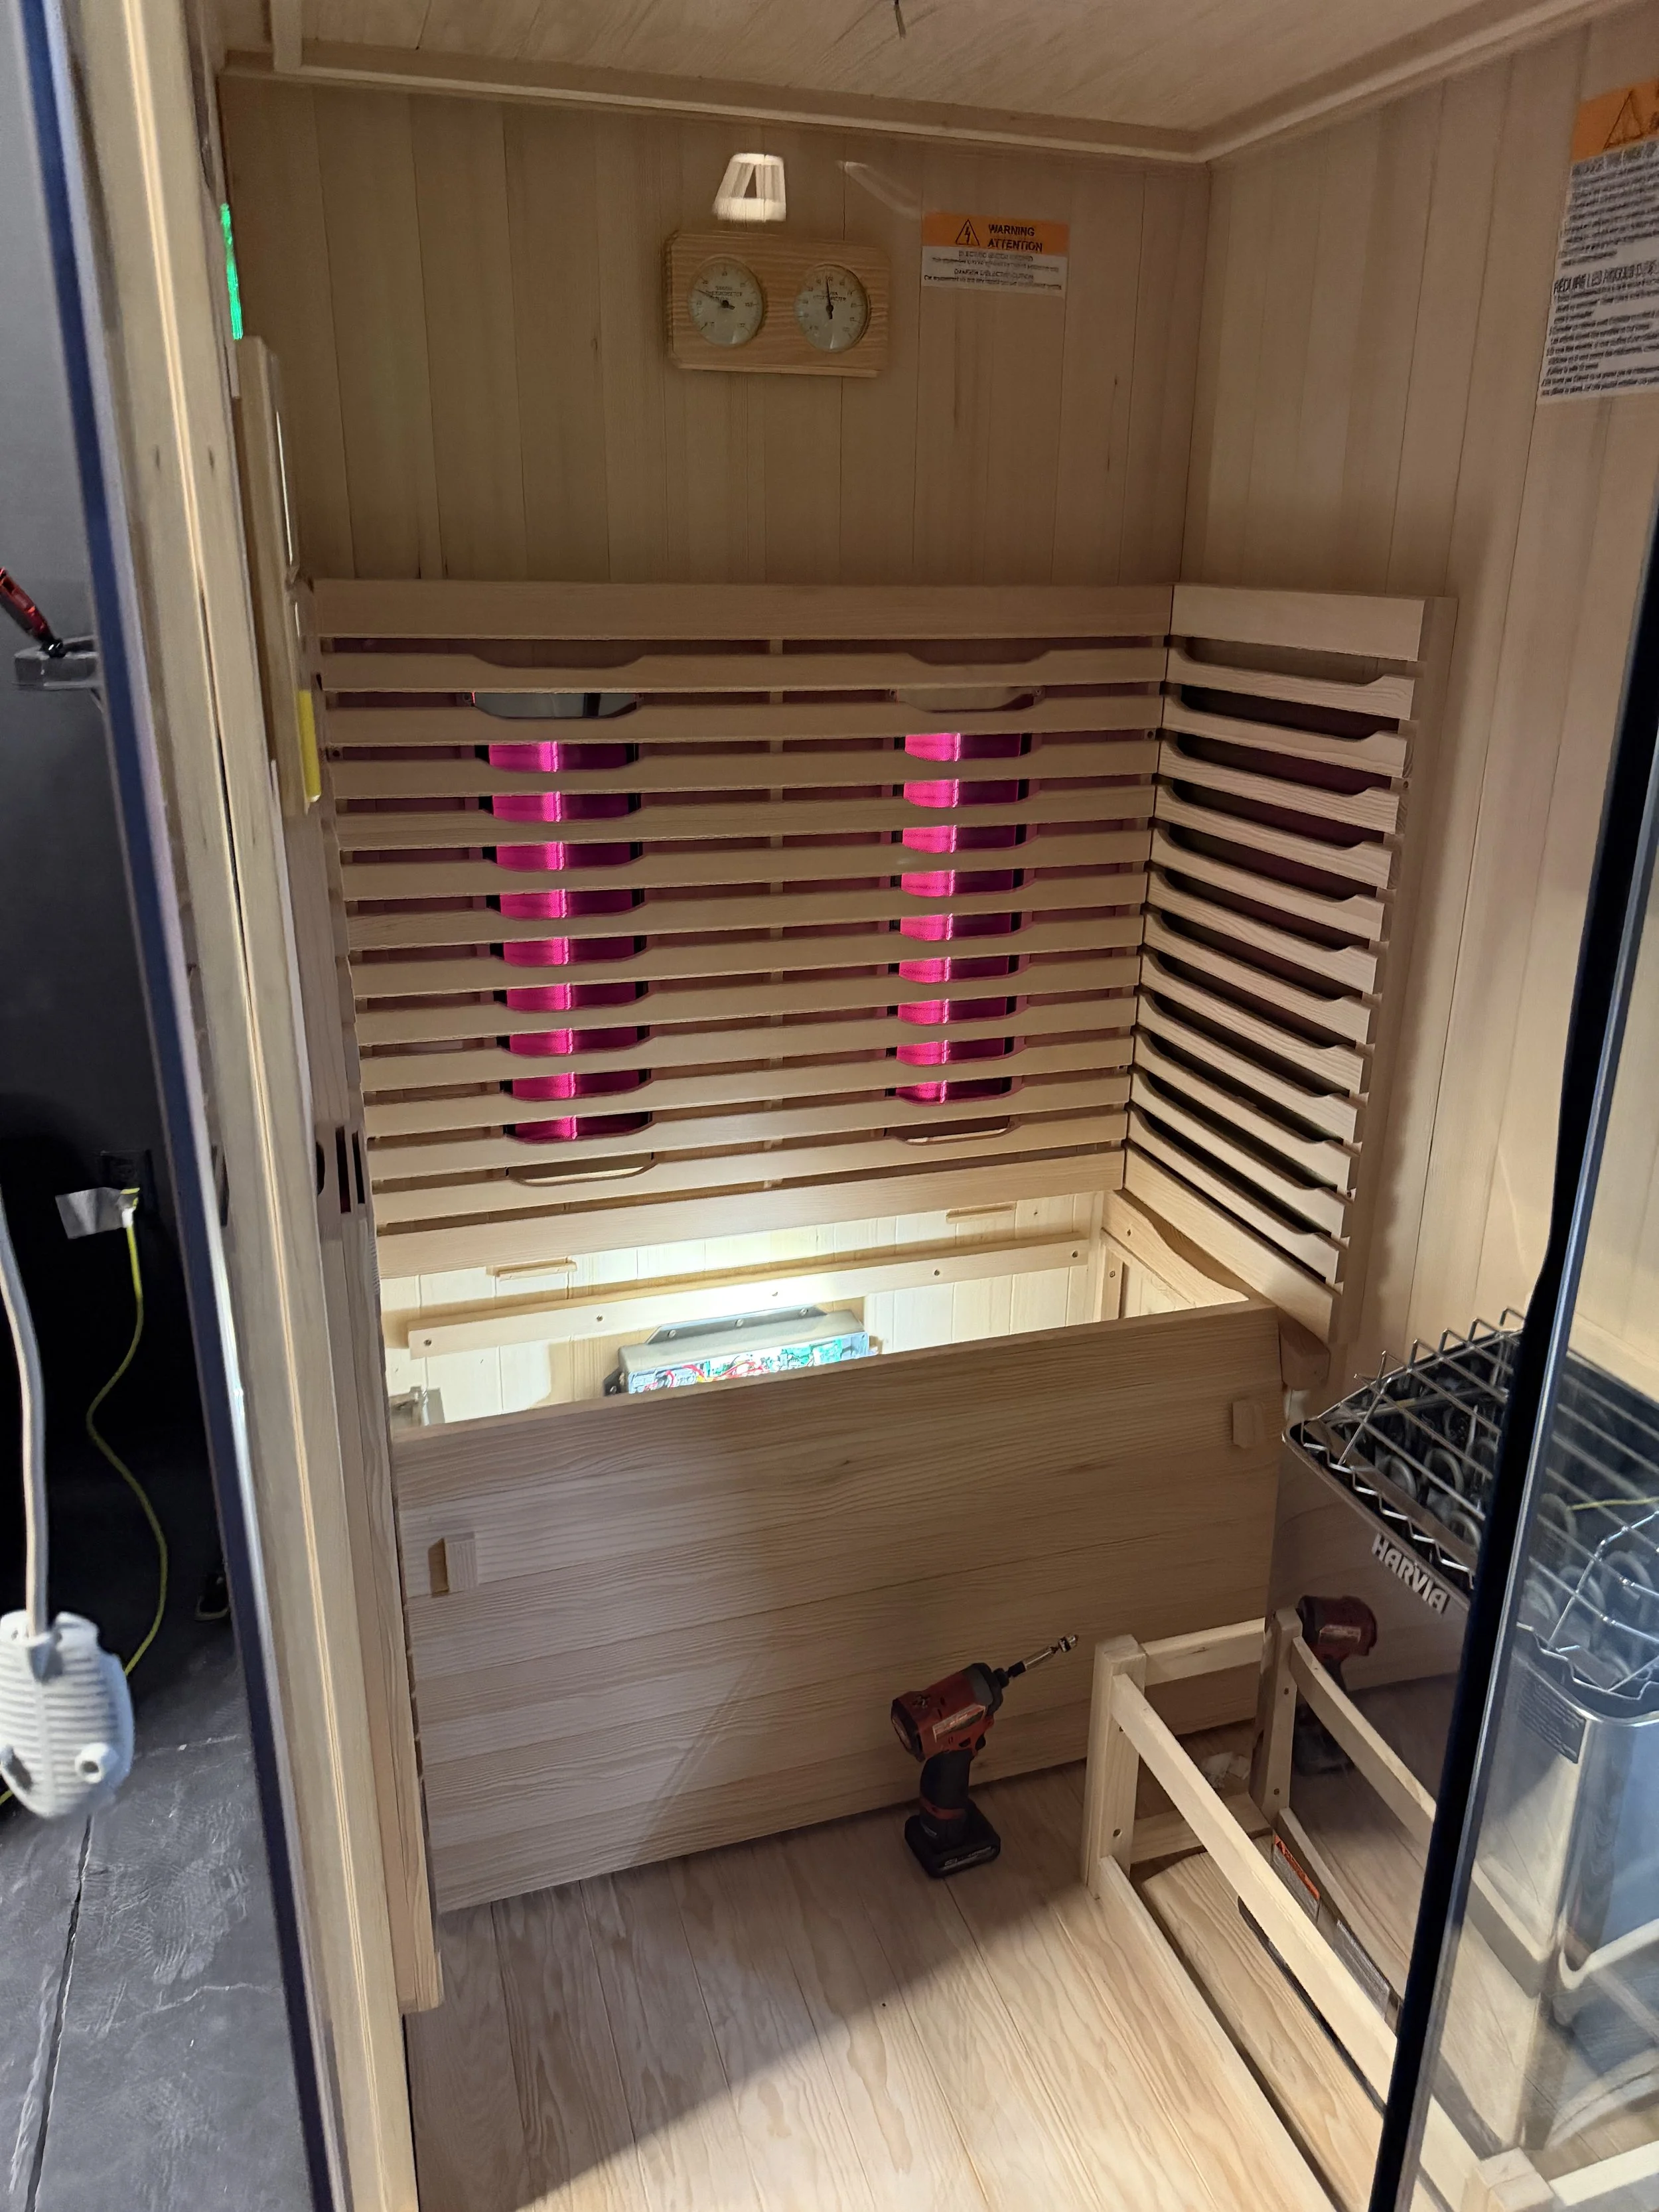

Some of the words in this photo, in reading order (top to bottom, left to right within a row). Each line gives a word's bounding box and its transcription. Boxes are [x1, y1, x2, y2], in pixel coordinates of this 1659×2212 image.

[988, 224, 1035, 236] WARNING
[987, 238, 1043, 252] ATTENTION
[1372, 1533, 1448, 1613] HARVIA
